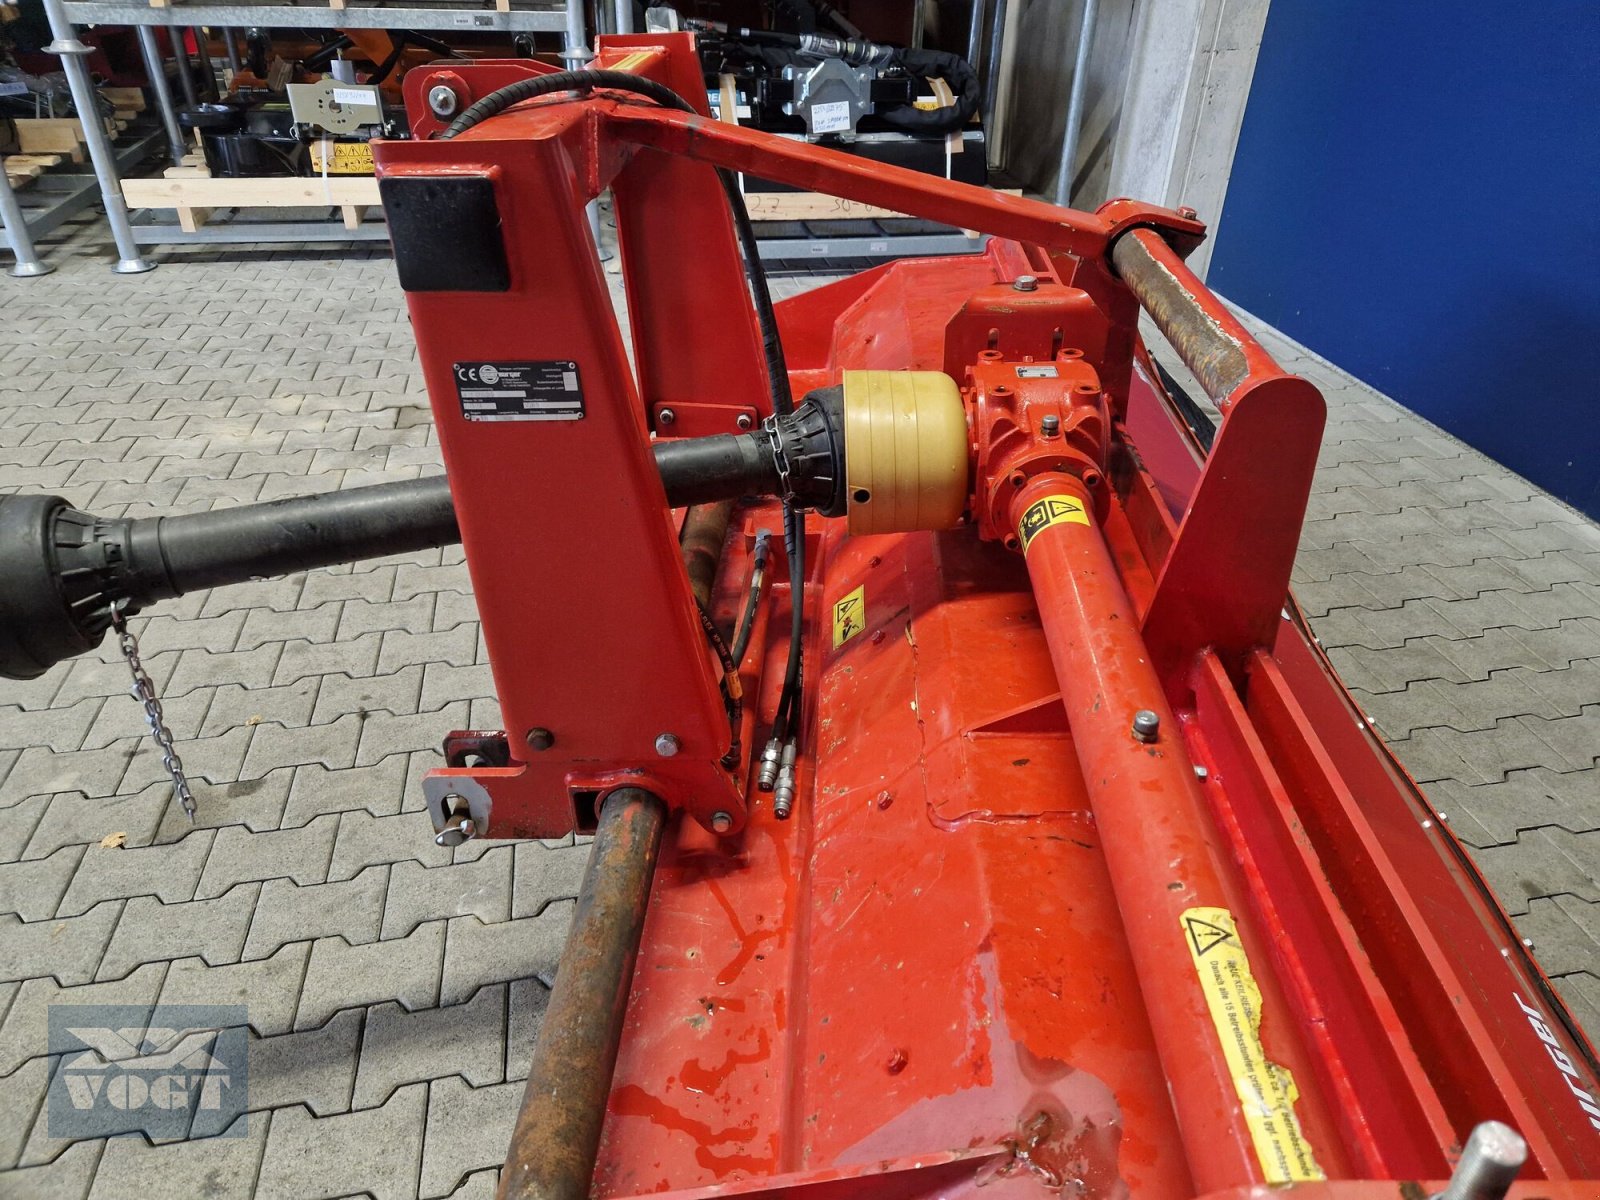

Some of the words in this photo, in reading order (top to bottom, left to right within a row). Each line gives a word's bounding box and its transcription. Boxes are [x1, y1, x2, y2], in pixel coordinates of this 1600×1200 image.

[1210, 960, 1225, 986] Danach
[1219, 987, 1230, 1000] alle
[1225, 1001, 1235, 1012] 15
